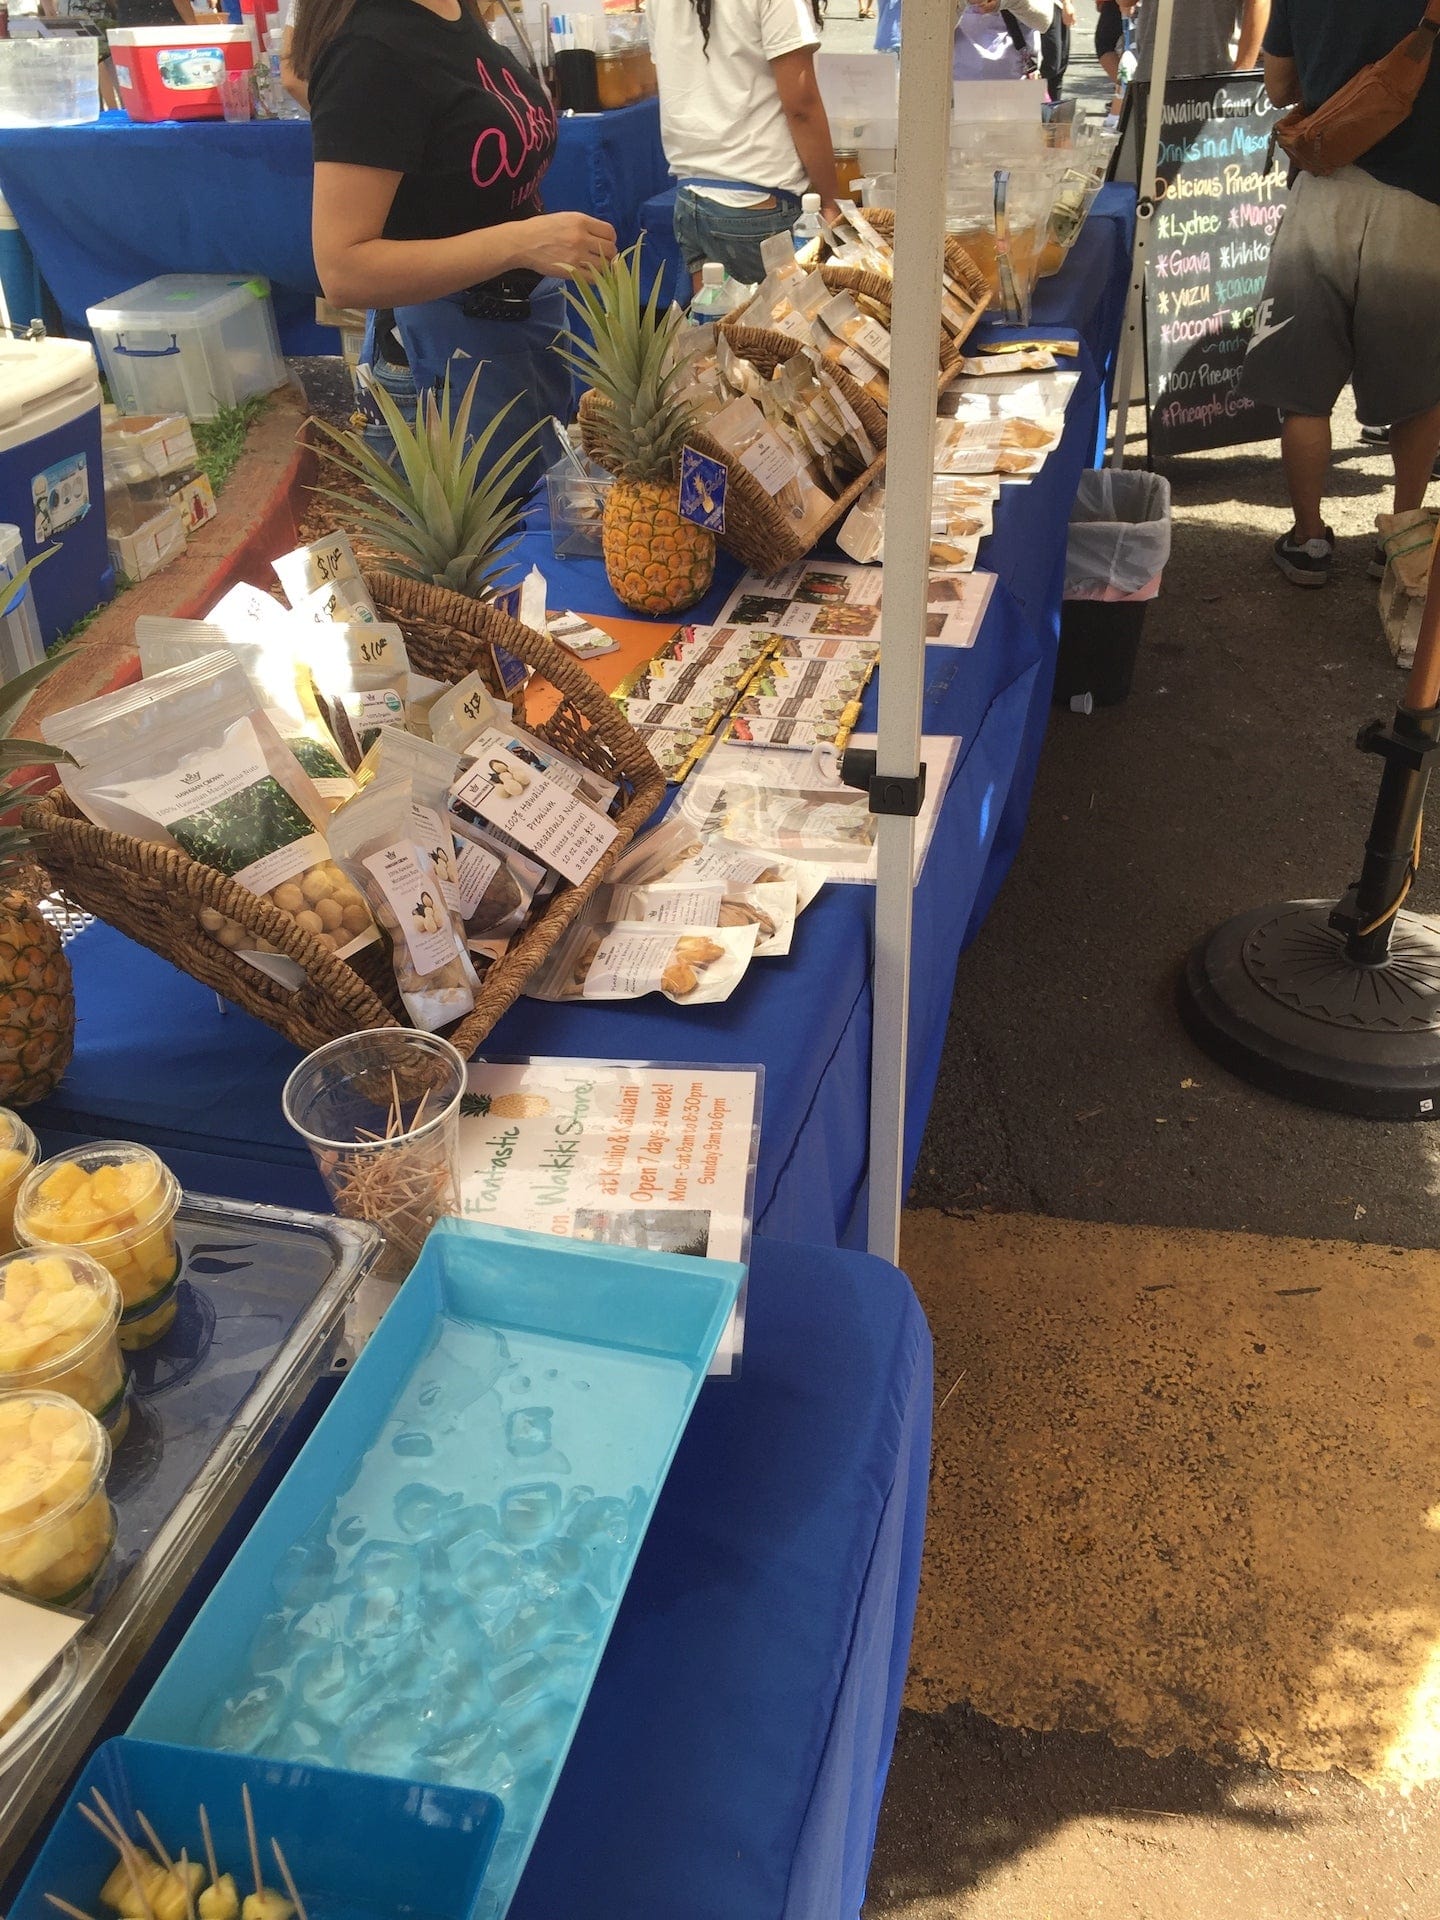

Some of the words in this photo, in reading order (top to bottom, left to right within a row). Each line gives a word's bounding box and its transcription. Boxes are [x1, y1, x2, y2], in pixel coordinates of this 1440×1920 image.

[1161, 100, 1211, 125] awaiian
[1212, 88, 1252, 123] Crown
[1156, 137, 1200, 167] Drinks
[1203, 138, 1216, 159] in
[1219, 140, 1229, 158] a
[1154, 174, 1222, 201] Delicious
[1223, 160, 1288, 202] Pineapple
[1171, 210, 1221, 245] Lychee
[1170, 249, 1211, 276] Guava
[1171, 308, 1230, 343] Coconut
[1219, 335, 1239, 353] and
[1198, 363, 1244, 391] Pineapp
[1169, 393, 1222, 427] Pineapple
[176, 790, 208, 810] Hawaiian
[207, 773, 243, 794] Macadamia
[243, 764, 259, 777] Nuts
[201, 773, 224, 788] CROWN
[505, 810, 525, 830] 100%
[520, 781, 551, 811] Hawaiian
[527, 800, 557, 832] Premium
[532, 815, 566, 852] Macadamia
[564, 798, 580, 816] Nuts
[550, 836, 569, 857] (roasted
[575, 812, 587, 830] salted)
[562, 856, 570, 865] 10
[585, 822, 596, 835] $15
[652, 1084, 674, 1120] week!
[683, 1082, 707, 1124] 8:30pm
[708, 1098, 731, 1117] 6pm
[684, 1125, 696, 1137] to
[704, 1127, 720, 1148] 9am
[712, 1117, 724, 1126] to
[607, 1136, 630, 1144] &
[646, 1130, 670, 1154] days
[676, 1137, 694, 1155] 8am
[465, 1126, 521, 1214] Fantastic
[531, 1134, 581, 1207] Waikiki
[607, 1144, 626, 1177] Kuhio
[638, 1155, 652, 1163] 7
[673, 1155, 690, 1171] Sat
[697, 1148, 723, 1185] Sunday
[601, 1178, 618, 1196] at
[629, 1166, 663, 1202] Open
[668, 1177, 688, 1202] Mon
[552, 1215, 569, 1235] on
